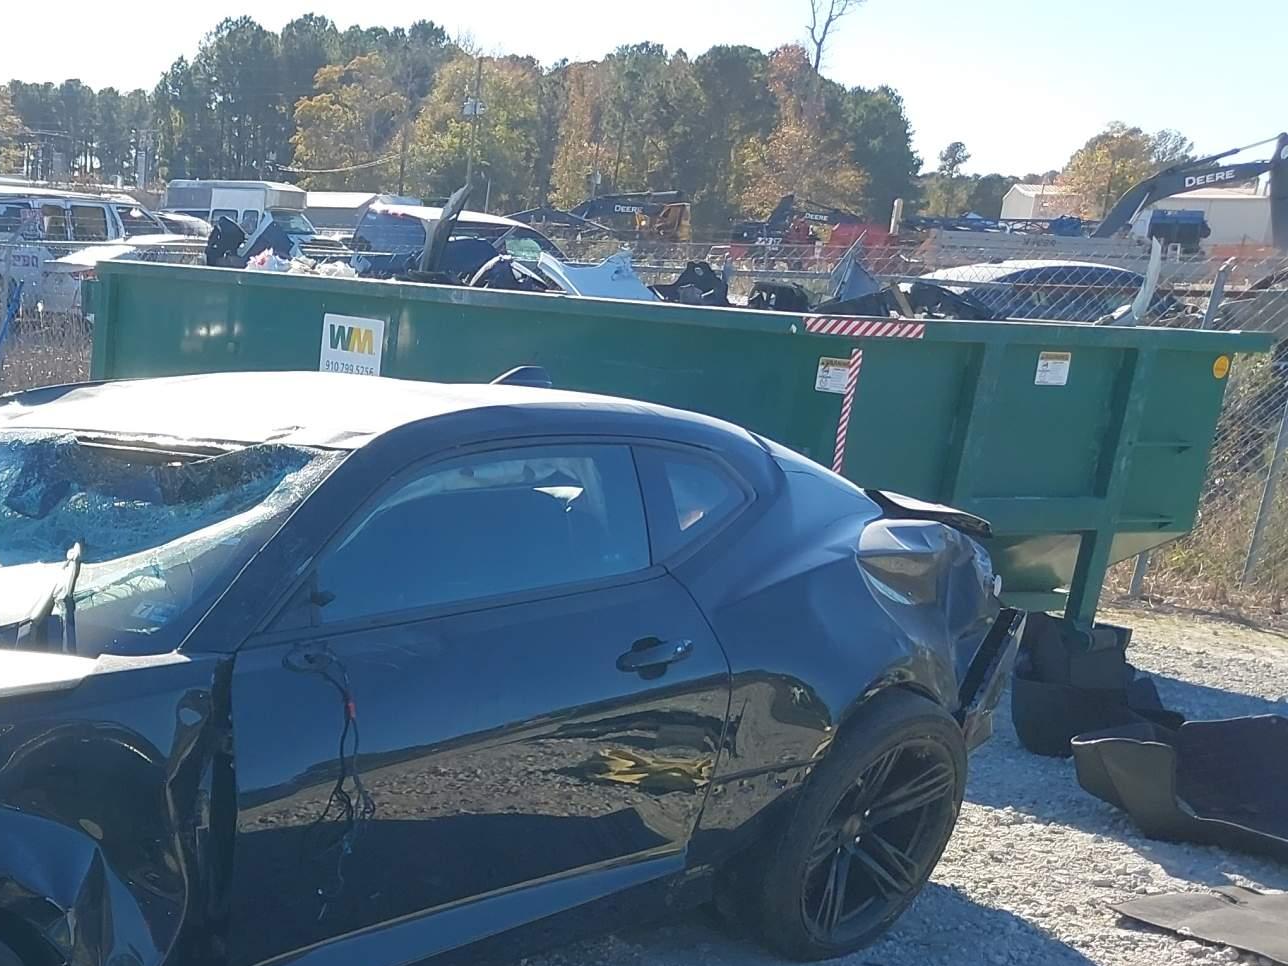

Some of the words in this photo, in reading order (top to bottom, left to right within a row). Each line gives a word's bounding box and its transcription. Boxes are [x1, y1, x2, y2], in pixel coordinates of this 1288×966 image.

[1185, 169, 1235, 187] DEERE
[805, 212, 828, 221] DEERE
[329, 323, 374, 355] WM
